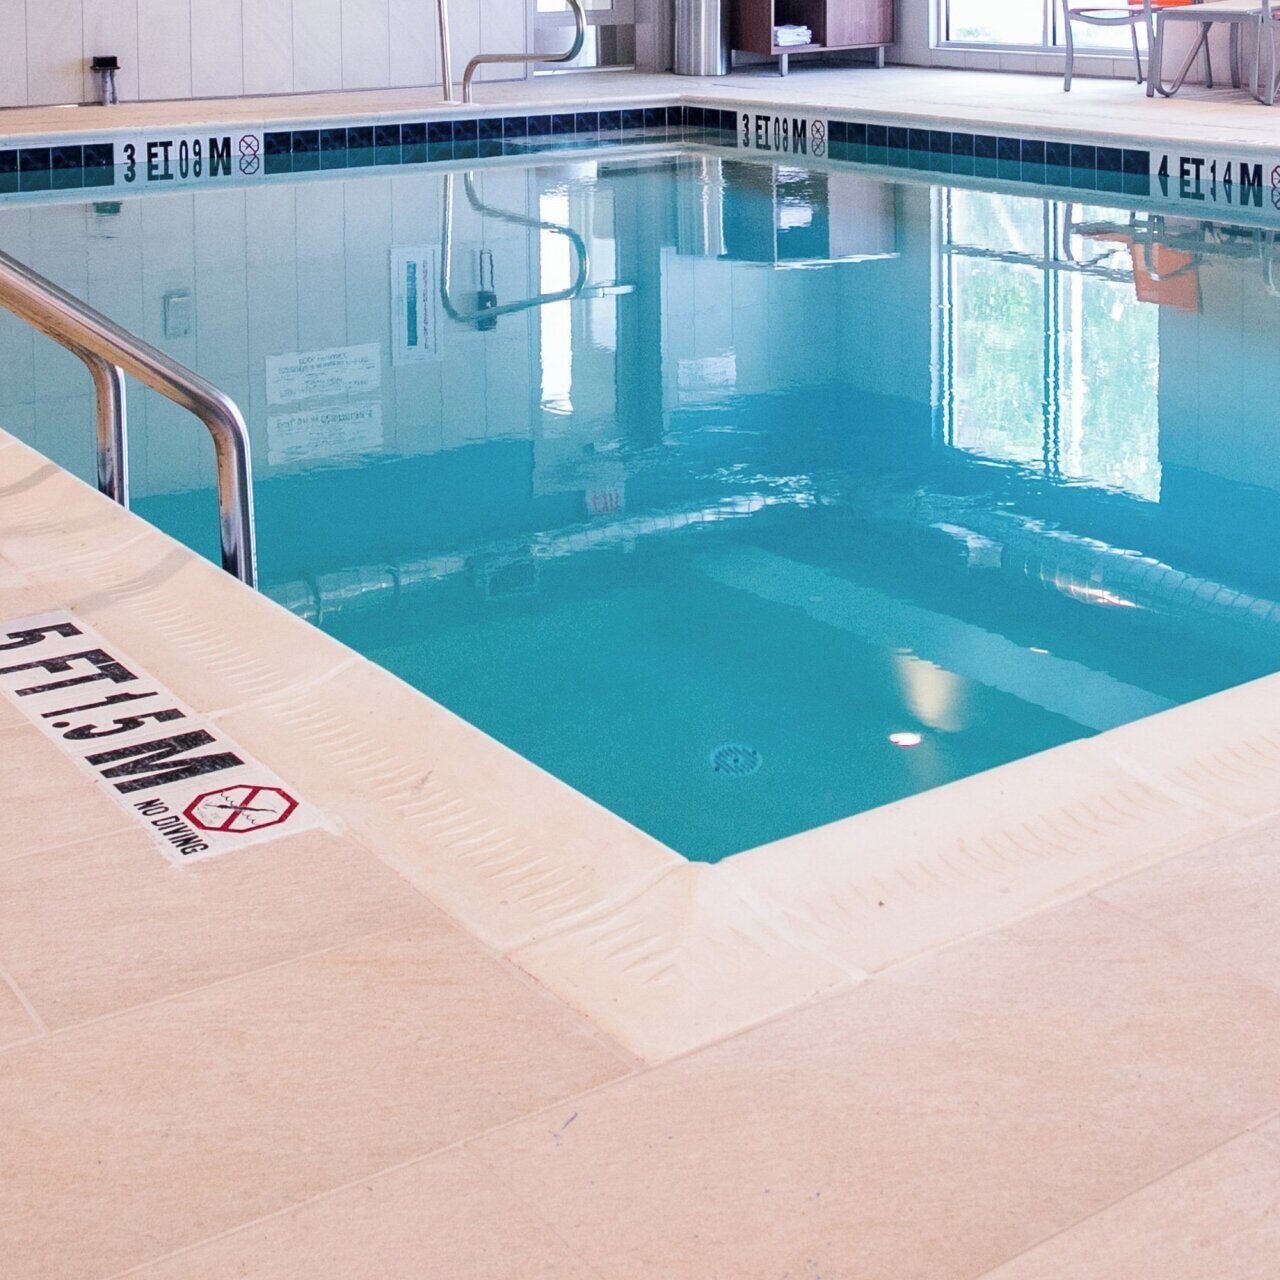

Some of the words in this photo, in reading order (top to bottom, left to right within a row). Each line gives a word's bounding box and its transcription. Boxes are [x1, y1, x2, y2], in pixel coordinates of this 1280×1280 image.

[41, 691, 187, 741] 1.5
[85, 729, 245, 795] M
[133, 798, 169, 816] NO
[150, 815, 209, 856] DIVING
